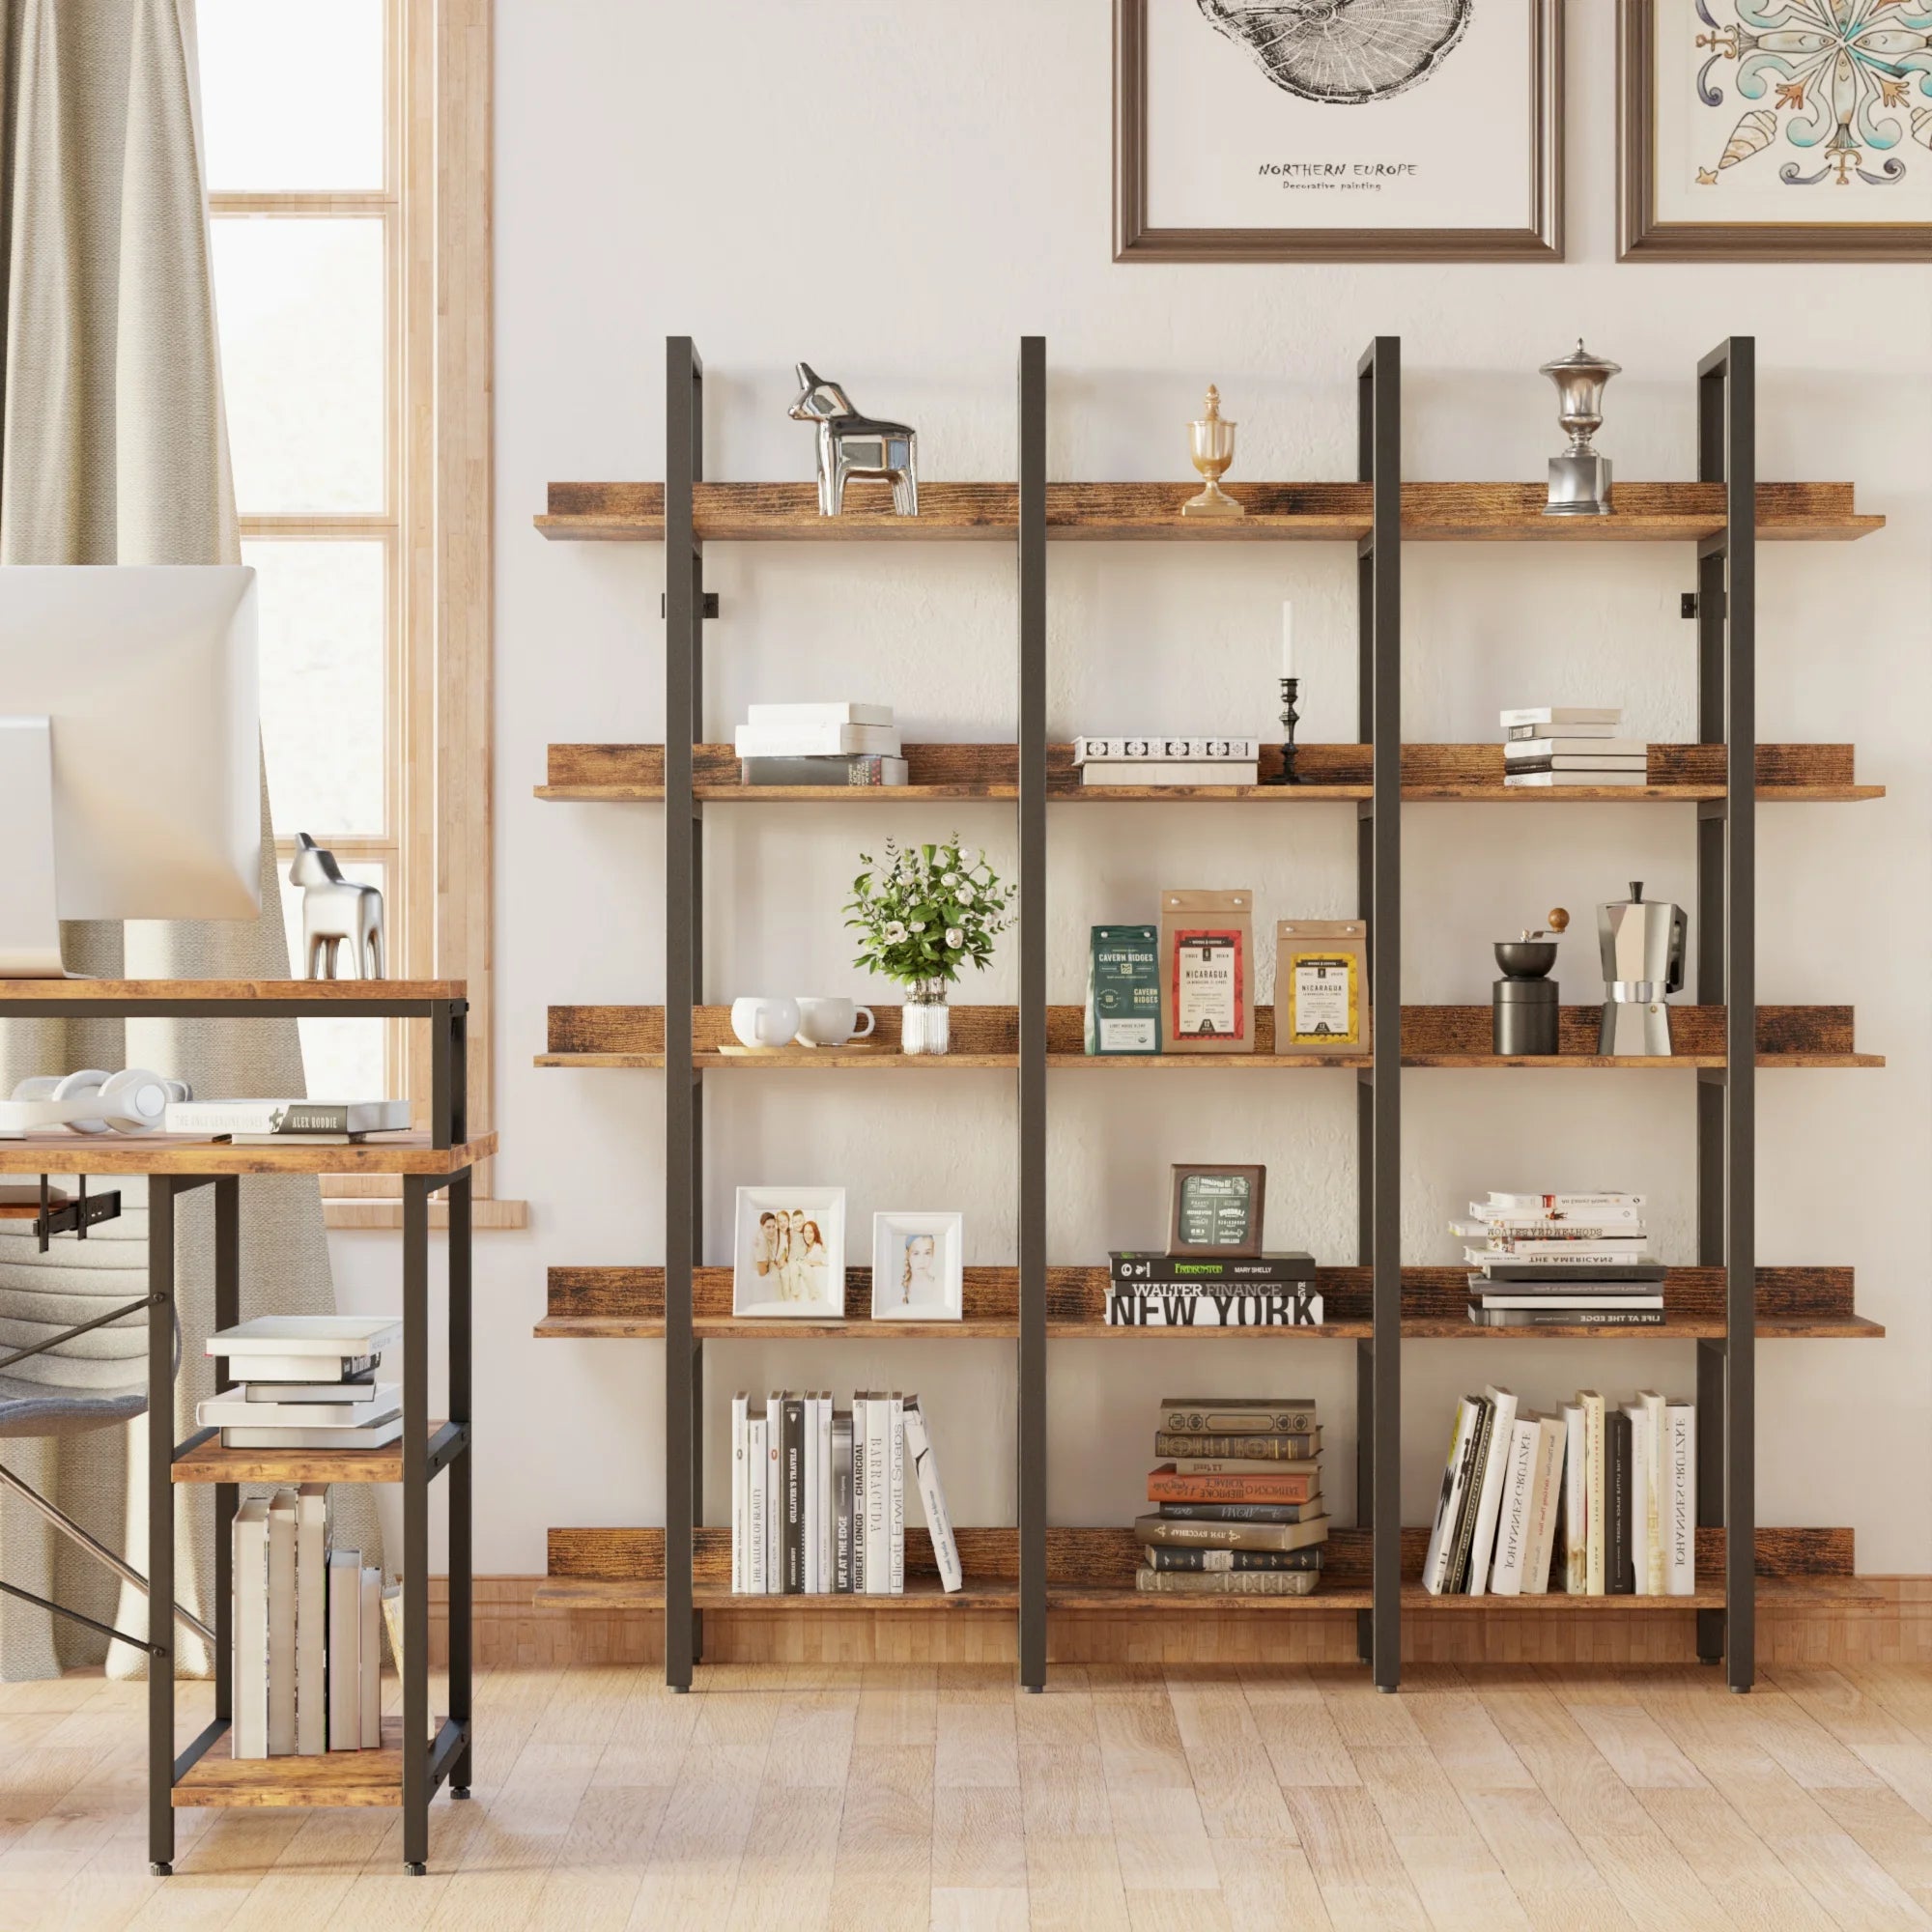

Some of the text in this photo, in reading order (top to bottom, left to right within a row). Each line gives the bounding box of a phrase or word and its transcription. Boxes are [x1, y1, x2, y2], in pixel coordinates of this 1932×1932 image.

[1259, 163, 1418, 176] NORTHERN EUROPE
[1283, 181, 1381, 191] Decorative painting
[1098, 953, 1153, 962] CAVERN RIDGES
[1185, 970, 1228, 979] NICARAGUA
[292, 1117, 310, 1128] ALEX
[1132, 1284, 1283, 1297] WALTER FINANCE
[1112, 1296, 1316, 1324] NEW YORK
[855, 1442, 864, 1495] CHARCOAL
[870, 1437, 882, 1532] BARRACUDA
[1206, 1478, 1244, 1489] ХОЛМСЕ
[1200, 1488, 1244, 1498] ШЕРЛОКЕ
[1245, 1485, 1298, 1496] ЗАПИСКИ О
[892, 1423, 902, 1588] Elliott Erwitt Snaps
[838, 1516, 847, 1539] EDGE
[855, 1514, 864, 1547] LONGO
[1170, 1529, 1208, 1538] БУССЕНАР
[753, 1488, 761, 1583] THE ALLURE OF BEAUTY
[838, 1540, 847, 1556] THE
[838, 1557, 847, 1569] AT
[855, 1549, 864, 1589] ROBERT
[838, 1571, 847, 1588] LIFE
